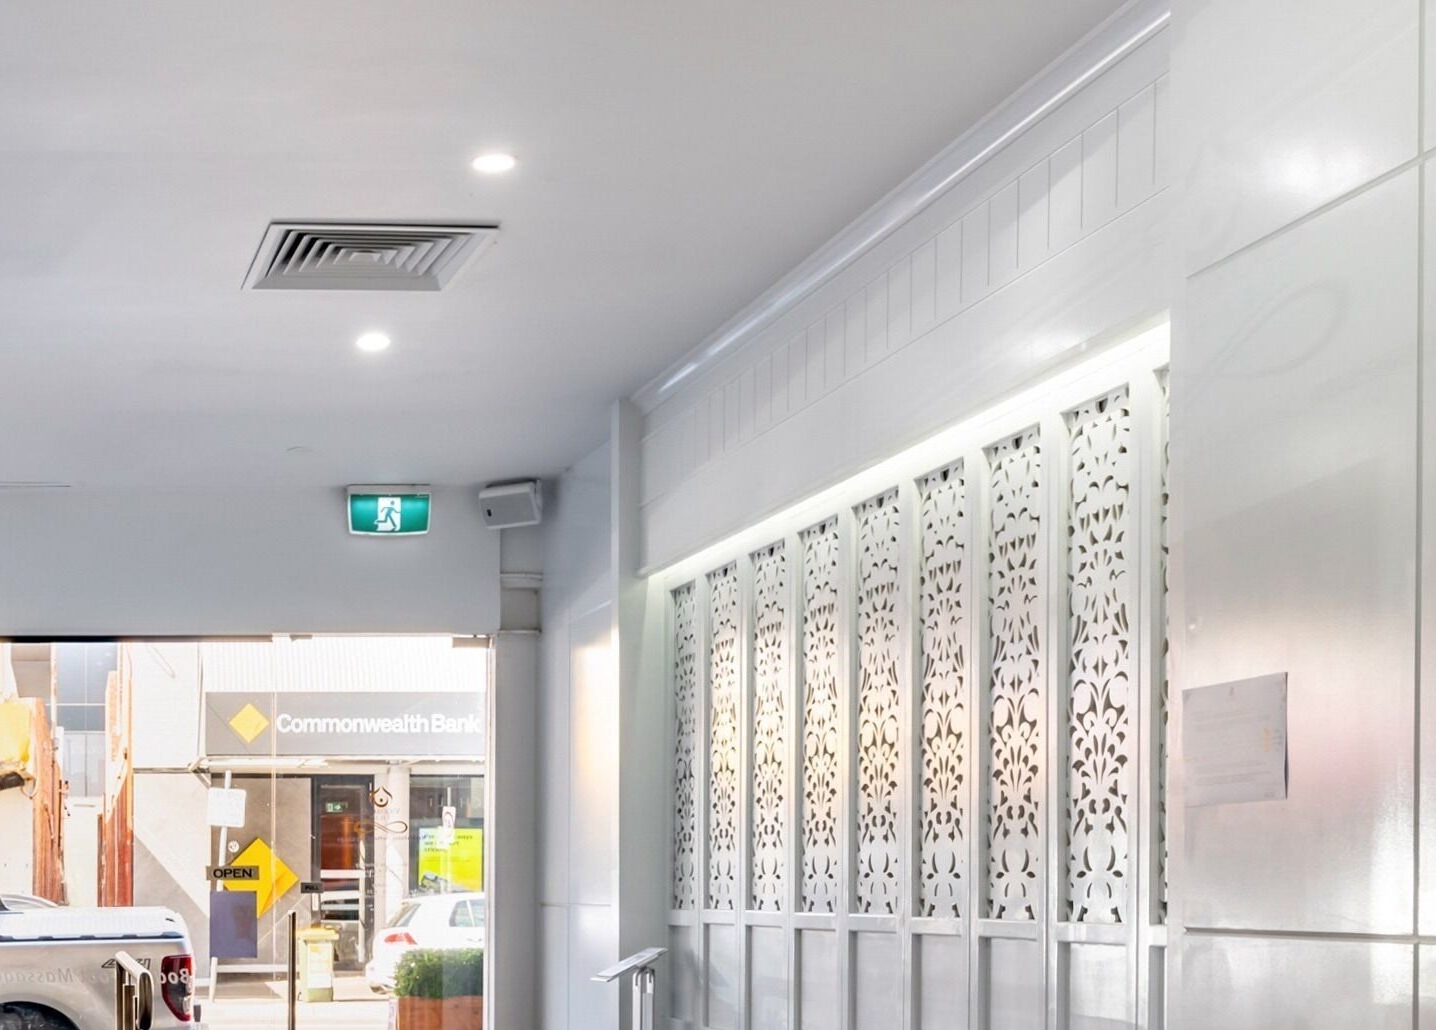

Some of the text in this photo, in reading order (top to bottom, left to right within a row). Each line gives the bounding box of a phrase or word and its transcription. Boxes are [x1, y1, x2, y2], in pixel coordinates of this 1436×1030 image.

[276, 713, 482, 733] Commonwealth Bank
[213, 868, 253, 878] OPEN
